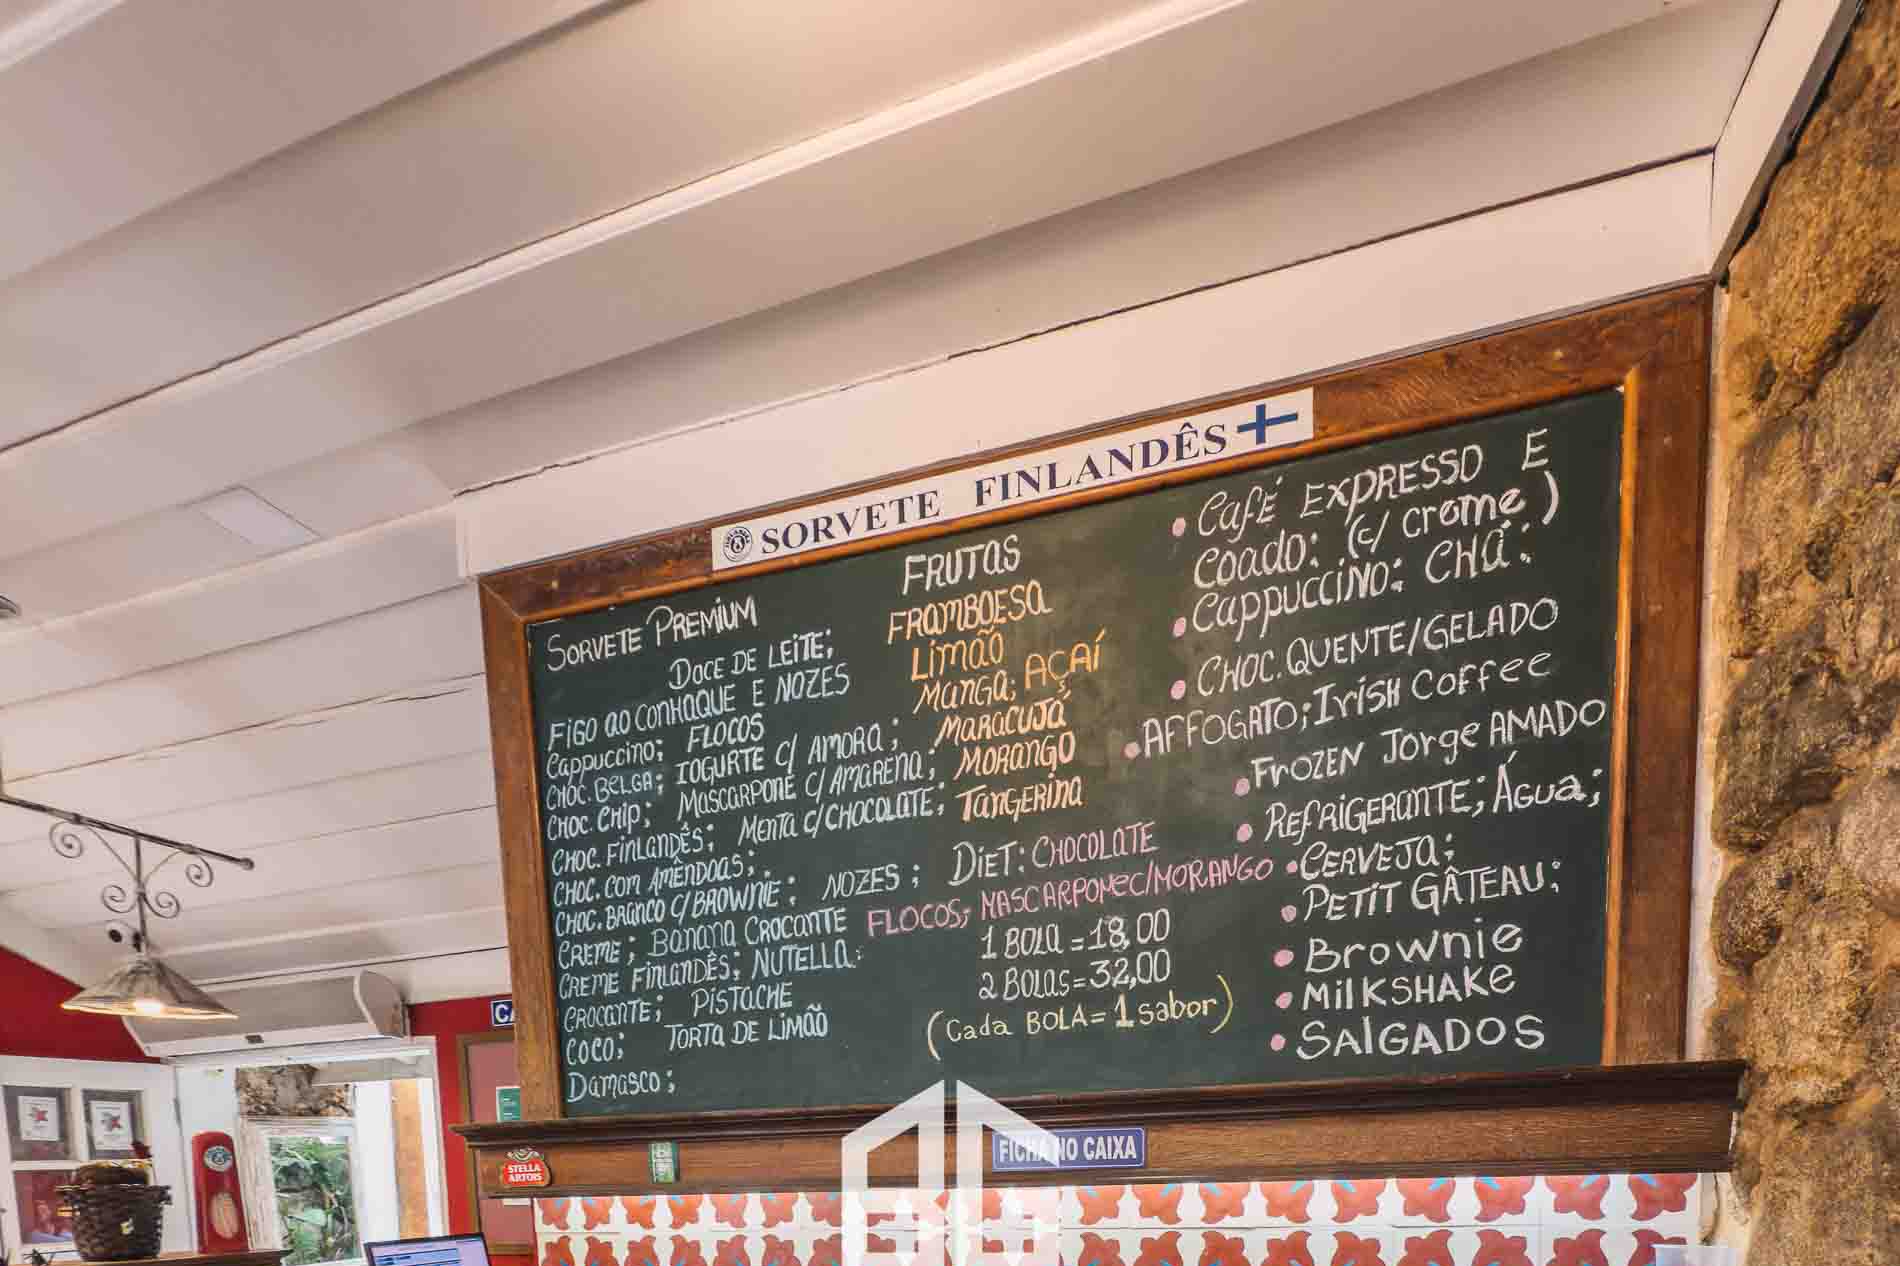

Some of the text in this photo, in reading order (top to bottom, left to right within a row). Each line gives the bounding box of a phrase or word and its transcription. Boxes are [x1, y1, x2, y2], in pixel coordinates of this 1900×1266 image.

[1521, 428, 1549, 471] E
[761, 422, 1227, 554] SORVETE FINLANDÊS
[902, 534, 1021, 595] FRUTAS
[547, 595, 758, 671] SORVETE PREMIUM
[731, 648, 757, 675] DE
[1025, 628, 1106, 693] AÇAÍ
[752, 679, 765, 707] E
[774, 662, 849, 704] NOZES
[687, 713, 764, 752] FLOCOS
[1490, 700, 1606, 746] AMADO
[676, 746, 764, 785] IOGURTE
[1032, 821, 1160, 868] CHOCOLATE
[1303, 881, 1402, 921] PETIT
[980, 925, 997, 959] 1
[559, 972, 619, 999] CREME
[979, 972, 998, 1000] 2
[732, 1021, 759, 1044] DE
[1083, 1136, 1137, 1160] CAIXA
[508, 1163, 542, 1173] STELLA
